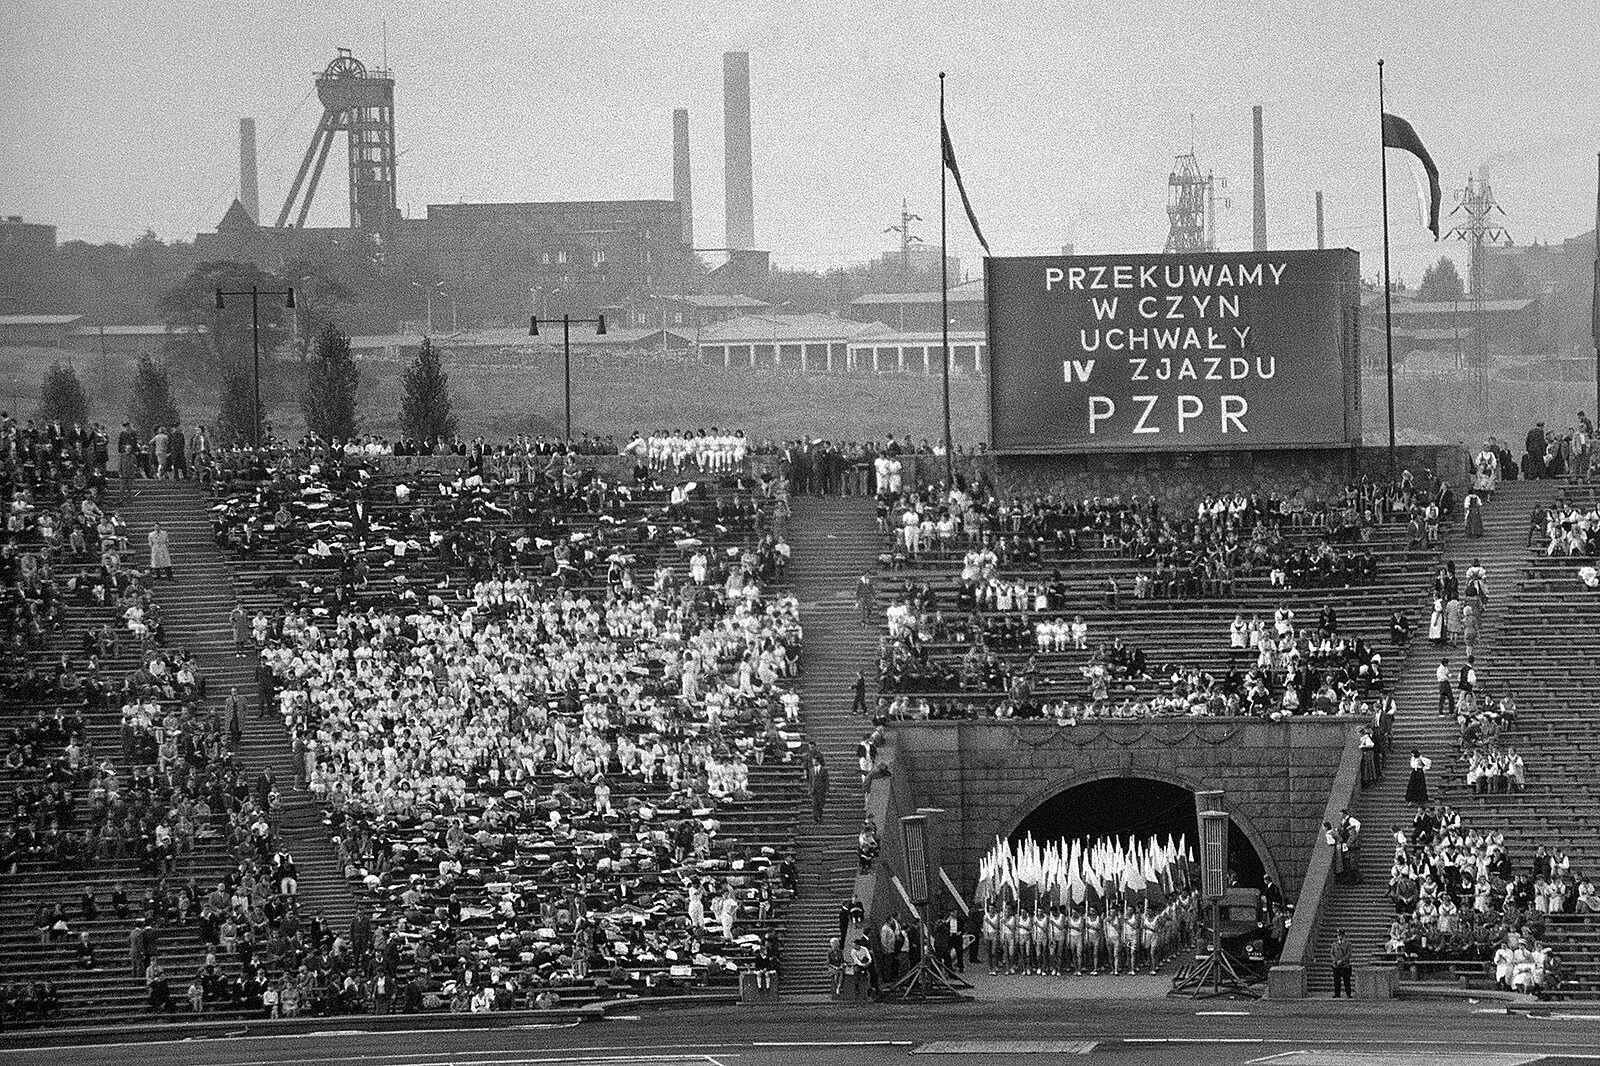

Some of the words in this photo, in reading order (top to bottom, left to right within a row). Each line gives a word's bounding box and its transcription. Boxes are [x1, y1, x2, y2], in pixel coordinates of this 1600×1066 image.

[1045, 264, 1287, 290] PRZEKUWAMY
[1092, 297, 1118, 320] W
[1138, 295, 1240, 319] CZYN
[1080, 327, 1251, 351] UCHWAŁY
[1063, 359, 1095, 383] IV
[1129, 357, 1276, 381] ZJAZDU
[1088, 395, 1248, 434] PZPR
